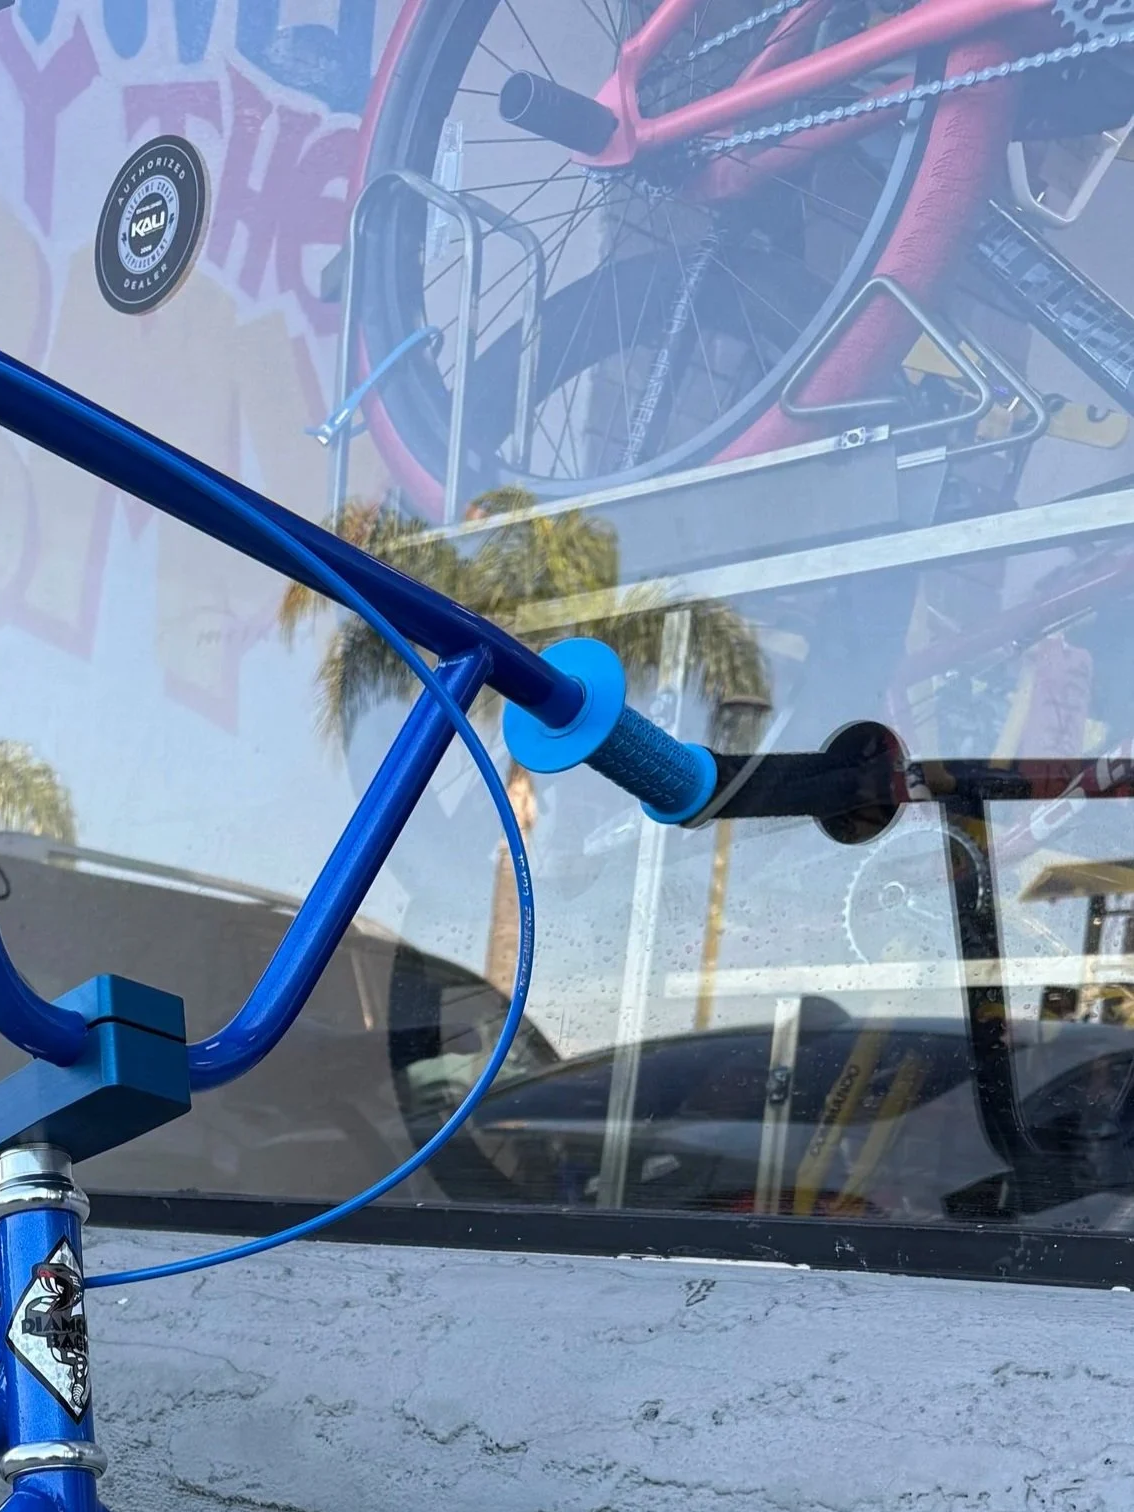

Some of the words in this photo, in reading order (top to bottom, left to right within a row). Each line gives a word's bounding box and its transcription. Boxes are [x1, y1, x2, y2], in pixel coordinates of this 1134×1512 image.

[117, 156, 186, 207] AUTHORIZED
[130, 210, 165, 237] KALI
[123, 263, 169, 290] DEALER
[21, 1316, 87, 1335] DIAM
